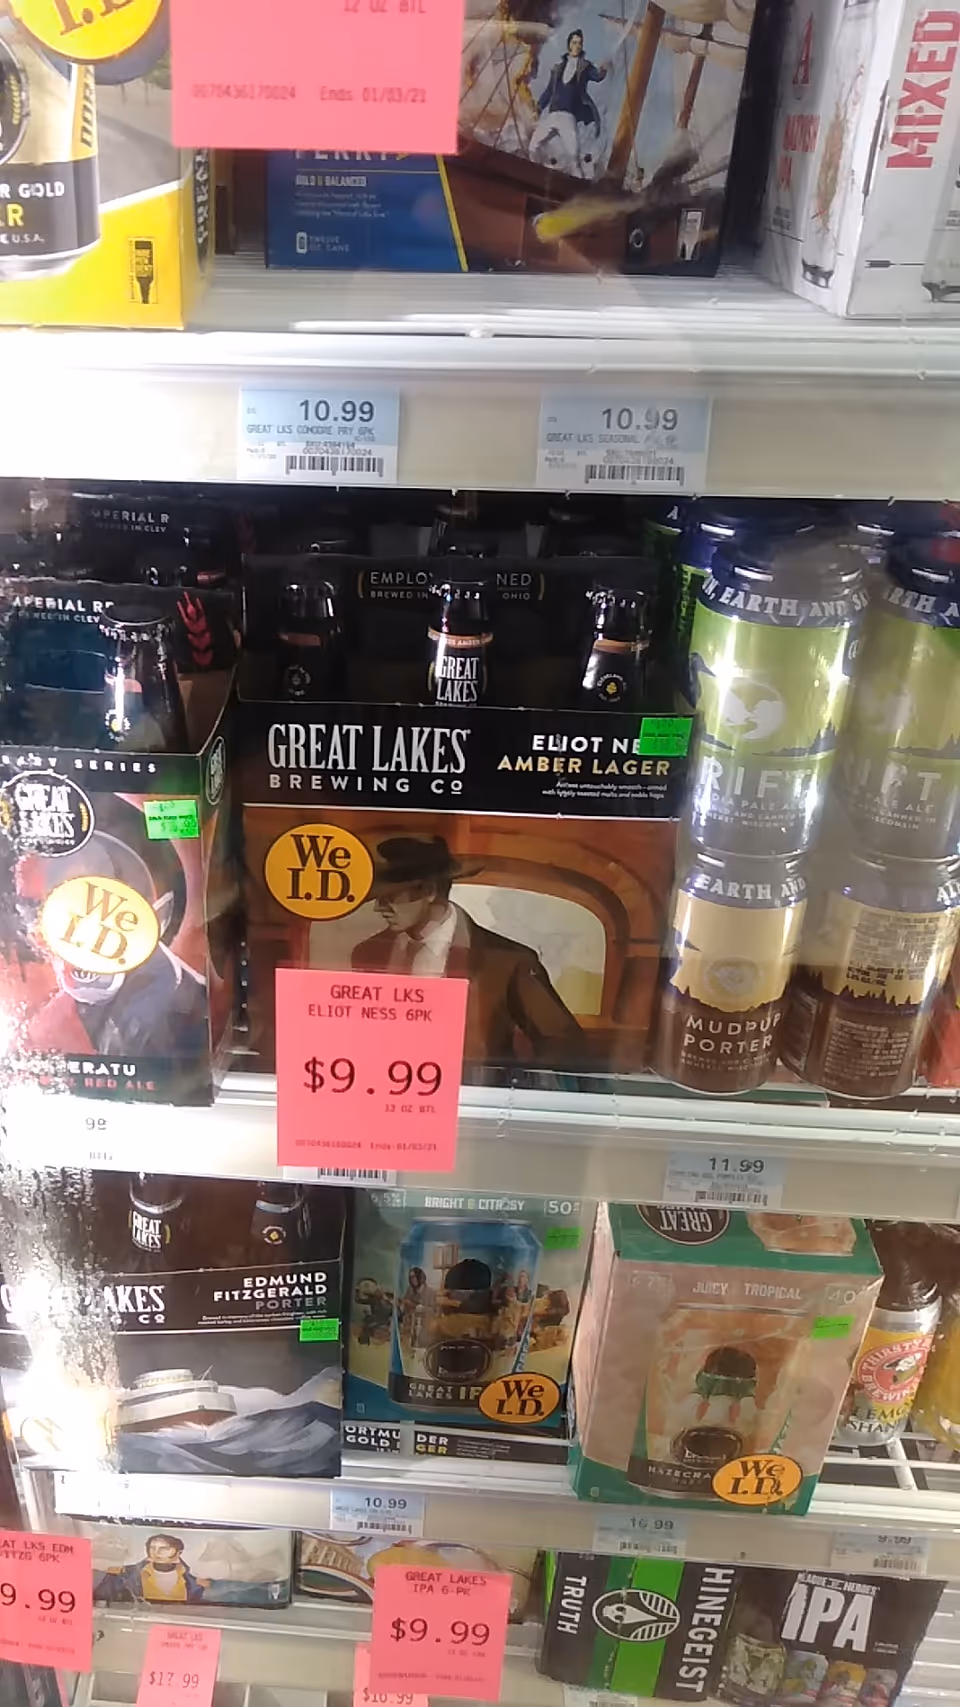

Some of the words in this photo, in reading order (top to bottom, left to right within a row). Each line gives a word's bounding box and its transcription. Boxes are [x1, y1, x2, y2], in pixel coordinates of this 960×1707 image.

[320, 86, 352, 101] Ends
[362, 87, 426, 103] 01/03/21
[886, 10, 960, 168] MIXED
[19, 181, 65, 197] GOLD
[325, 176, 367, 187] BALANCED
[299, 399, 374, 422] 10.99
[601, 407, 678, 431] 10.99
[246, 425, 271, 434] GREAT
[277, 425, 292, 434] LKS
[546, 433, 574, 442] GREAT
[577, 434, 593, 443] LKS
[370, 591, 412, 600] BREWED
[417, 592, 429, 600] IN
[502, 592, 531, 601] OHIO
[719, 586, 799, 617] EARTH
[809, 600, 847, 617] AND
[438, 655, 480, 680] GREAT
[437, 678, 478, 702] LAKES
[268, 723, 364, 770] GREAT
[372, 725, 470, 774] LAKES
[532, 735, 603, 753] ELIOT
[74, 758, 157, 774] SERIES
[497, 755, 583, 774] AMBER
[592, 759, 672, 776] LAGER
[269, 774, 410, 793] BREWING
[701, 755, 812, 800] RIFT
[858, 758, 942, 801] IFT
[290, 834, 352, 869] We
[286, 867, 356, 903] I.D.
[698, 873, 772, 900] EARTH
[780, 878, 807, 898] AND
[84, 881, 139, 932] We
[60, 914, 133, 965] I.D.
[330, 984, 383, 1001] GREAT
[393, 987, 425, 1004] LKS
[308, 1003, 353, 1018] ELIOT
[361, 1006, 397, 1021] NESS
[405, 1008, 433, 1023] 6PK
[685, 1013, 781, 1035] MUDPUP
[683, 1033, 773, 1055] PORTER
[67, 1060, 136, 1077] ERATU
[303, 1056, 443, 1097] $9.99
[84, 1077, 118, 1090] RED
[125, 1079, 156, 1092] ALE
[384, 1103, 397, 1113] 12
[401, 1105, 414, 1114] OZ
[418, 1105, 437, 1114] BTL
[708, 1157, 765, 1174] 11.99
[424, 1196, 465, 1210] BRIGHT
[547, 1200, 573, 1215] 50
[132, 1210, 163, 1235] GREAT
[243, 1272, 327, 1288] EDMUND
[103, 1285, 165, 1313] AKES
[213, 1284, 327, 1302] FITZGERALD
[692, 1281, 729, 1296] JUICY
[744, 1283, 801, 1300] TROPICAL
[255, 1296, 327, 1311] PORTER
[408, 1391, 453, 1400] LAKES
[409, 1383, 453, 1392] GREAT
[501, 1379, 545, 1400] We
[496, 1398, 545, 1416] I.D.
[346, 1434, 391, 1447] GOLD
[415, 1444, 448, 1454] GER
[416, 1434, 449, 1446] DER
[647, 1464, 712, 1480] HAZECRA
[738, 1459, 786, 1478] We
[364, 1496, 408, 1510] 10.99
[24, 1541, 46, 1551] LKS
[406, 1571, 442, 1583] GREAT
[450, 1574, 487, 1586] LAKES
[0, 1582, 76, 1614] 9.99
[413, 1584, 435, 1594] IPA
[556, 1576, 588, 1635] TRUTH
[781, 1583, 875, 1652] IPA
[390, 1617, 490, 1647] $9.99
[675, 1567, 735, 1693] HINEGEIST
[149, 1671, 200, 1689] $1799
